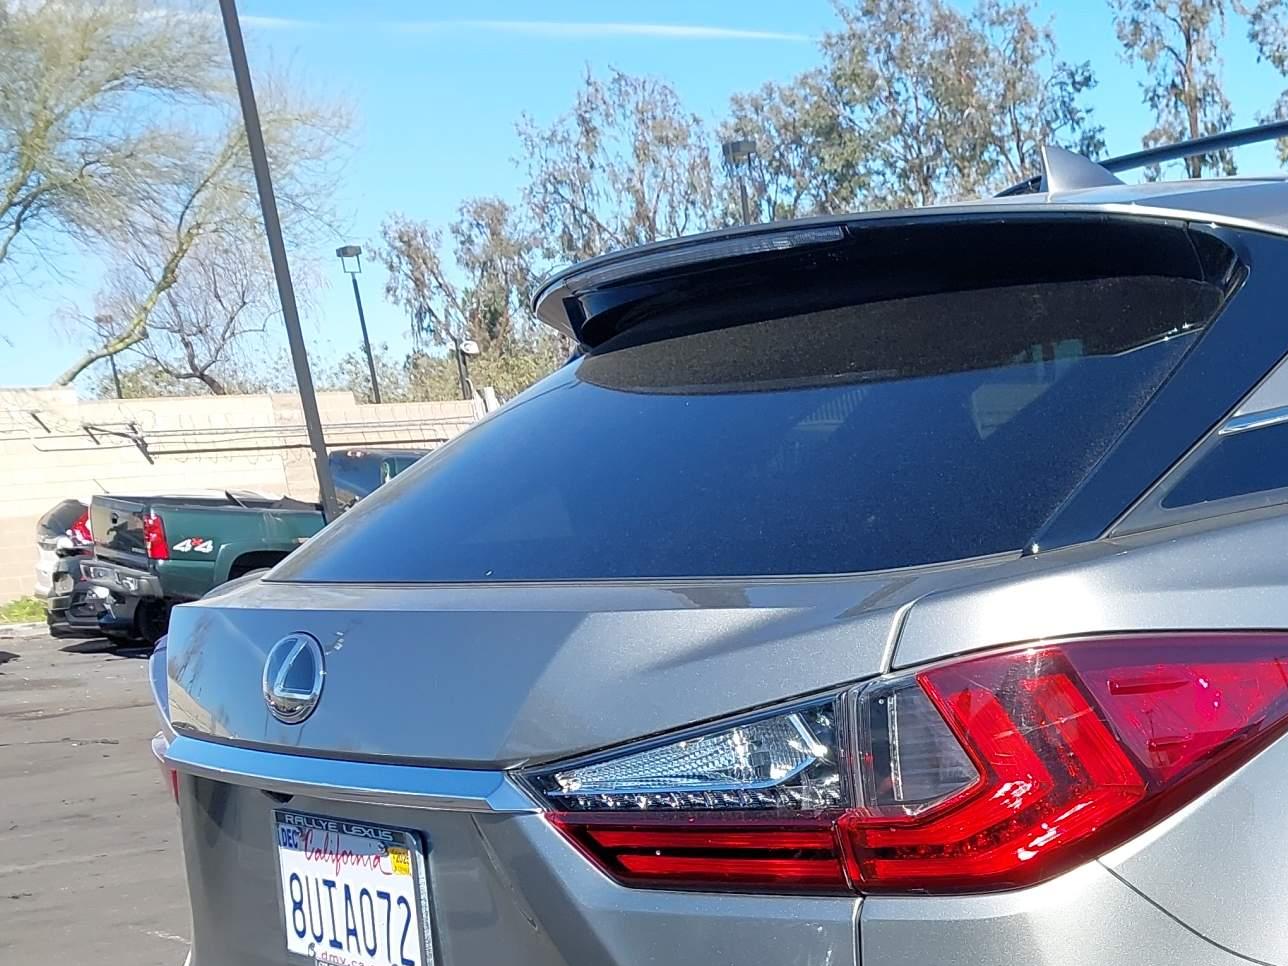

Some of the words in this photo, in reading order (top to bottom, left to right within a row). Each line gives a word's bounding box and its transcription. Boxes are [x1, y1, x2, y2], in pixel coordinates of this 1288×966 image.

[280, 826, 299, 849] DEC
[285, 814, 338, 832] RALLYE
[342, 823, 394, 842] LEXUS
[301, 828, 392, 877] California
